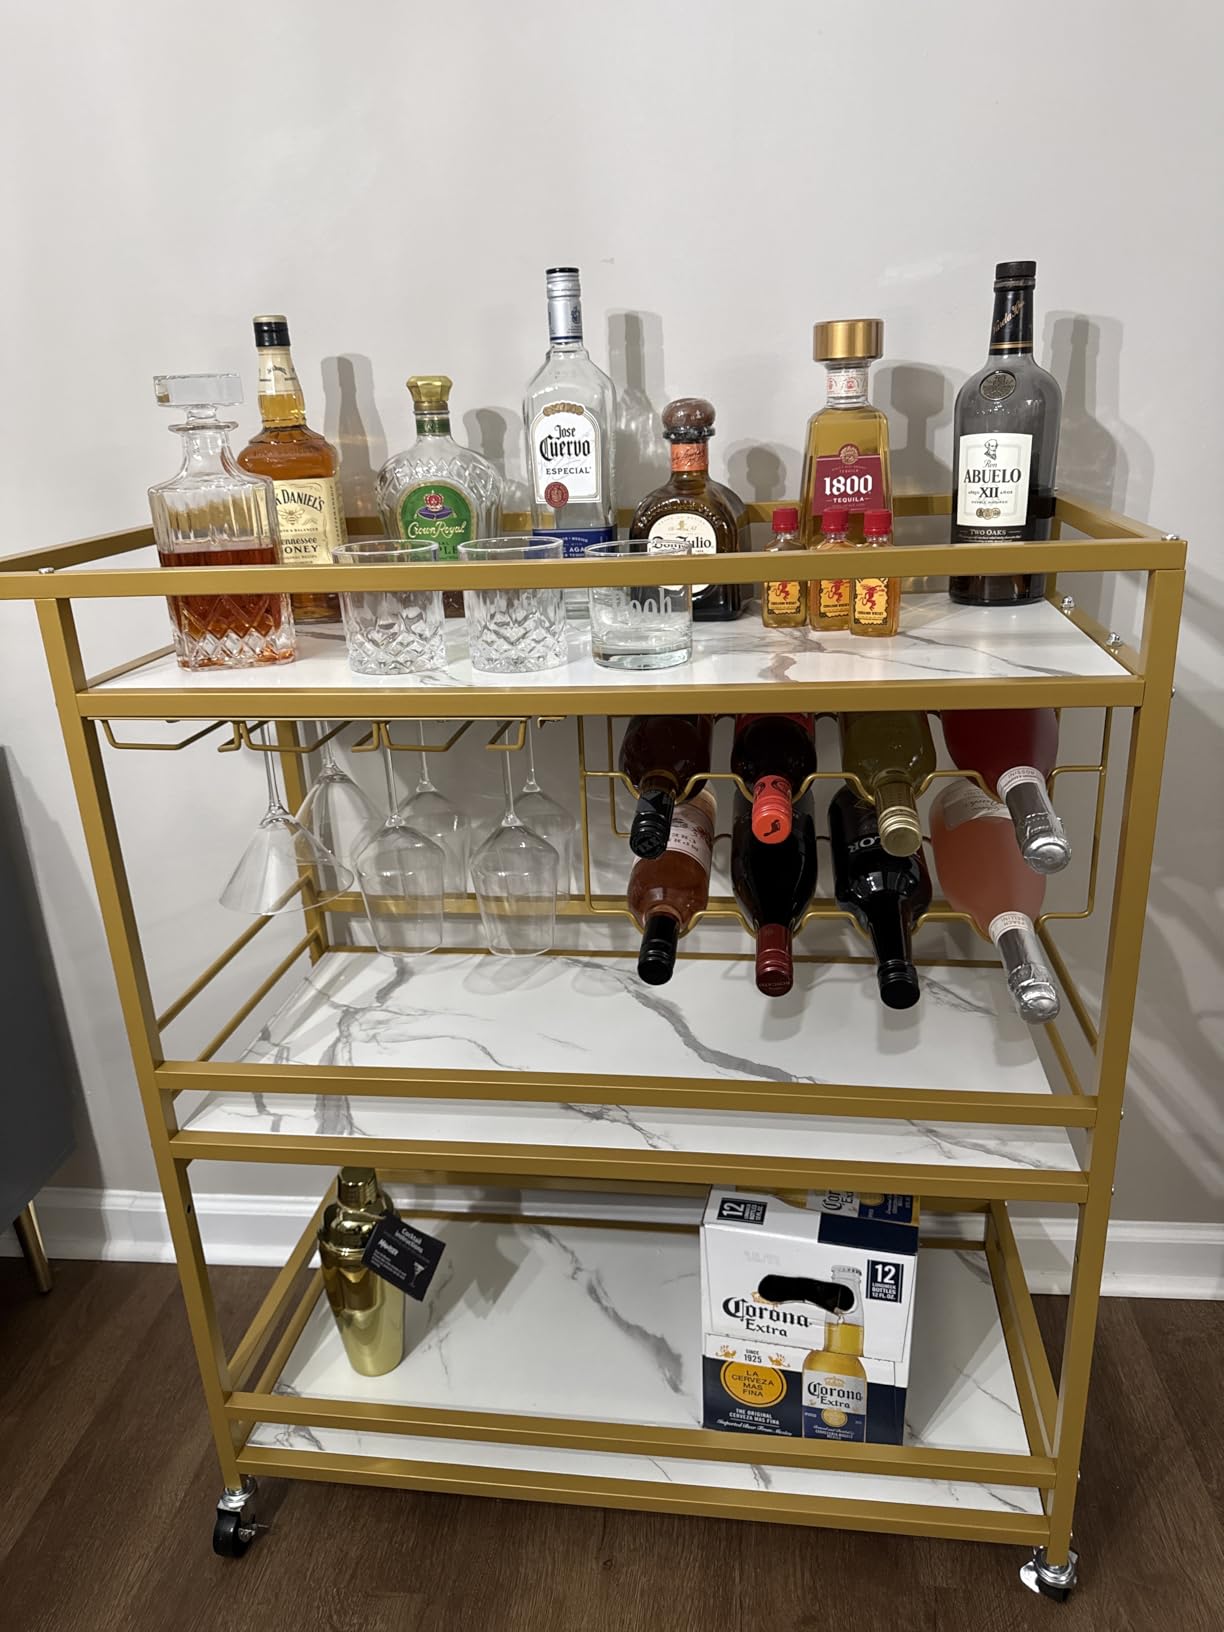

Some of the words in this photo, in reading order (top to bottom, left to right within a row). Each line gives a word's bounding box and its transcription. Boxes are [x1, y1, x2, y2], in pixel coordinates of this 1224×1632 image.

[554, 424, 576, 440] Jose
[539, 434, 591, 462] Cuervo
[546, 467, 590, 475] ESPECIAL
[963, 468, 1022, 484] ABUELO
[824, 474, 873, 496] 1800
[979, 487, 1000, 498] XII
[281, 489, 325, 513] DANIEL'S
[407, 521, 437, 539] Crown
[430, 520, 467, 539] Royal
[284, 545, 318, 555] ONEY
[722, 1202, 744, 1217] 12
[875, 1263, 896, 1284] 12
[722, 1296, 808, 1328] Corona
[744, 1319, 788, 1338] Extra
[743, 1353, 763, 1364] 1925
[745, 1348, 760, 1356] SINCE
[731, 1374, 775, 1386] CERVEZA
[742, 1382, 763, 1391] MAS
[742, 1388, 764, 1398] FINA
[807, 1381, 863, 1402] Corona
[820, 1395, 850, 1409] Extra
[729, 1411, 753, 1421] CERVEZA
[766, 1417, 780, 1425] FINA
[735, 1407, 746, 1415] THE
[746, 1409, 773, 1419] ORIGINAL
